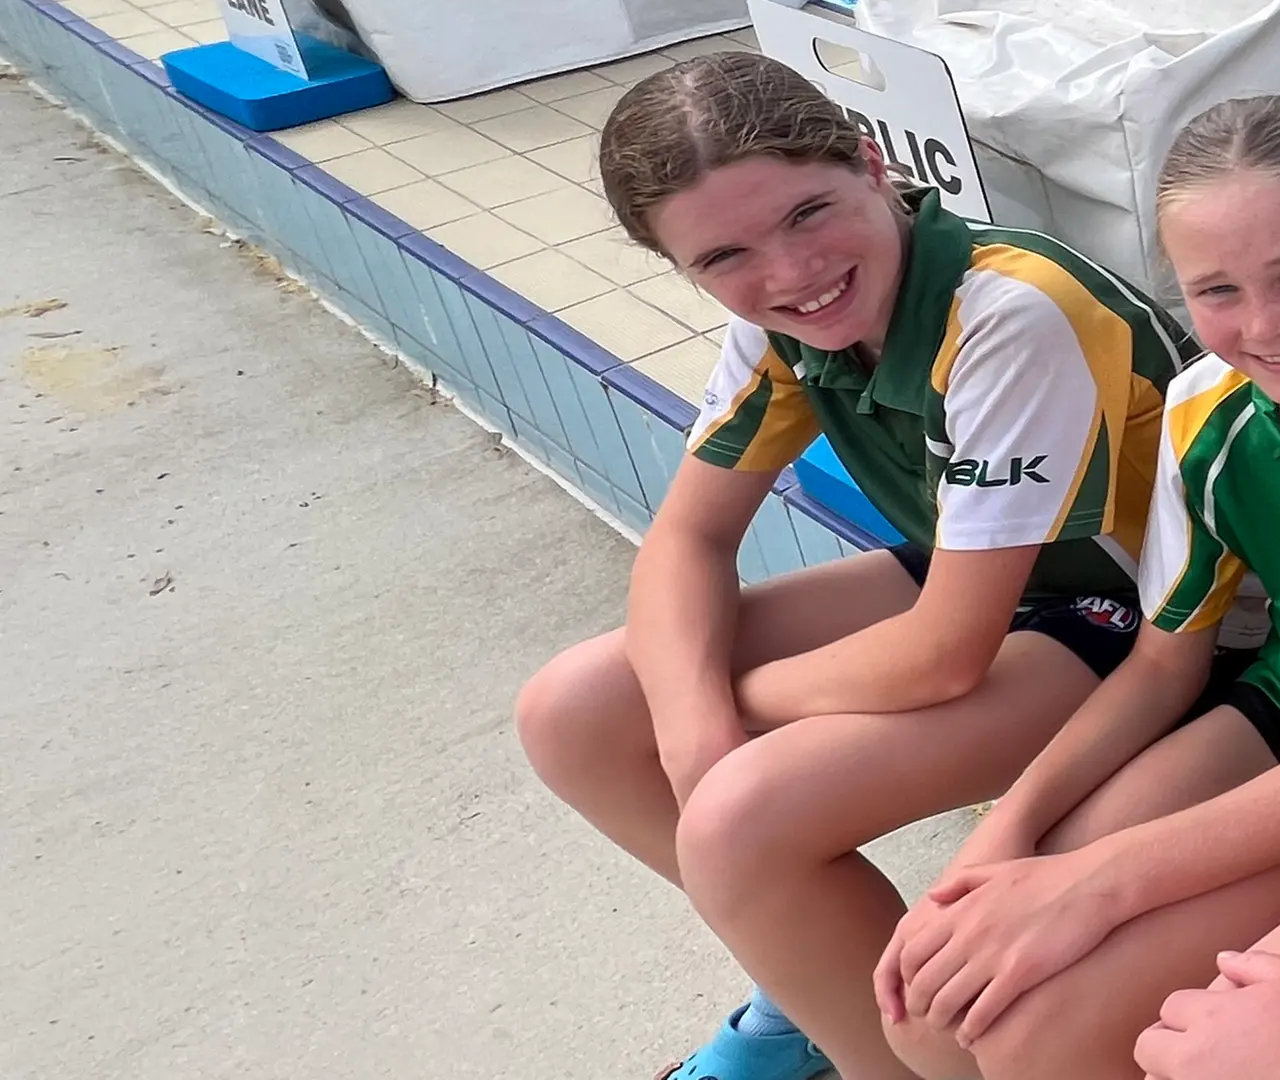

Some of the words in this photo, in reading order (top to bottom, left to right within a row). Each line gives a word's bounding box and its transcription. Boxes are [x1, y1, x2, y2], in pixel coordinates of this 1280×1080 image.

[845, 107, 963, 196] BLIC
[944, 454, 1052, 488] BLK
[1075, 595, 1130, 630] AFL
